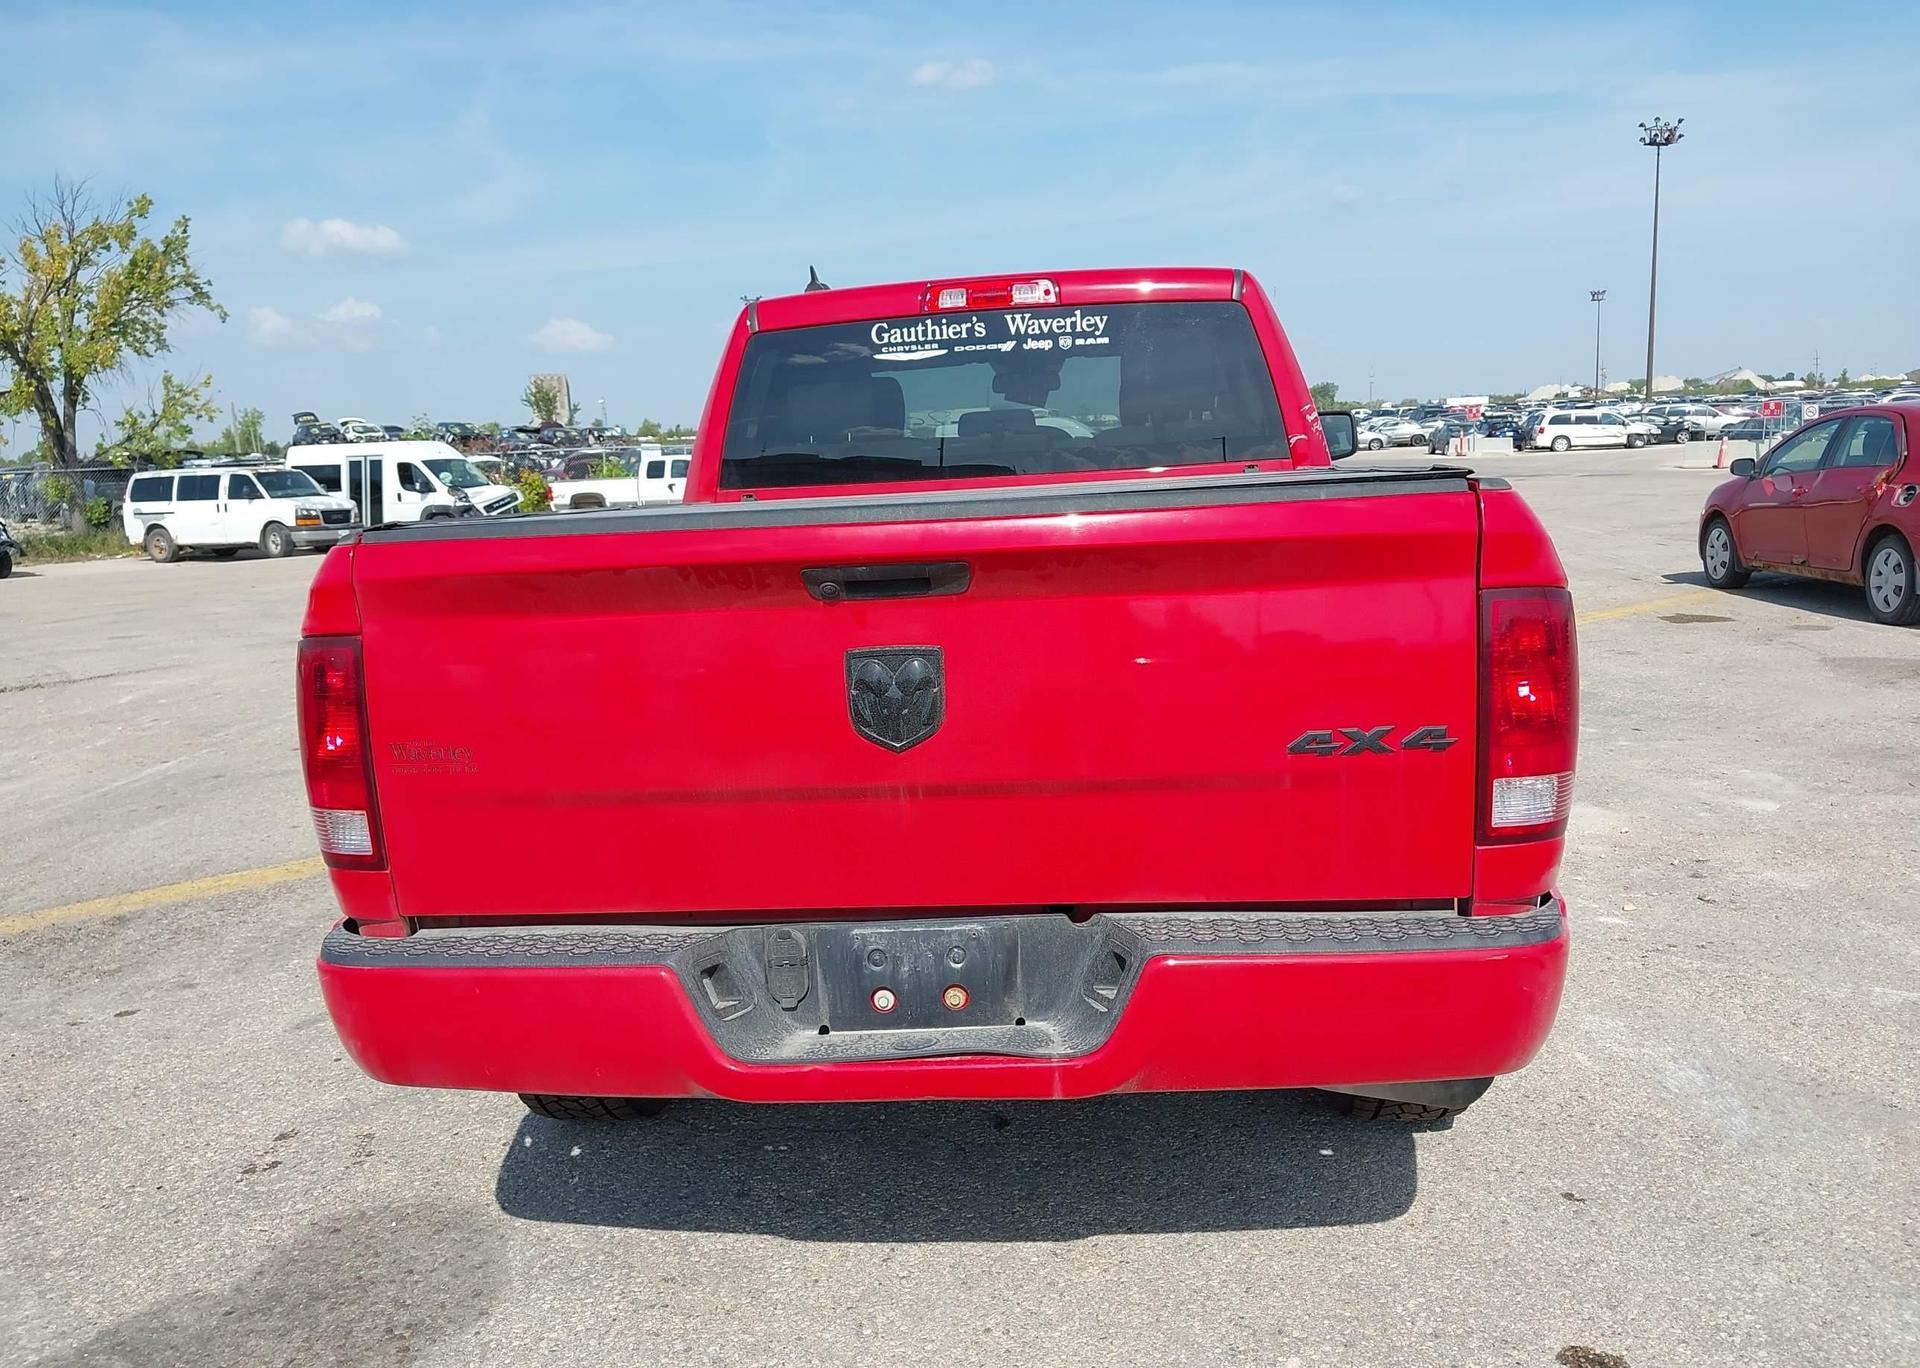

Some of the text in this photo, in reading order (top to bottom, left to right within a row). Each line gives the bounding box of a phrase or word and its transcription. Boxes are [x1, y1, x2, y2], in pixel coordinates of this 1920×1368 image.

[871, 310, 1108, 345] Gauthier's Waverley
[882, 343, 938, 352] CHRYSLER
[1022, 338, 1053, 350] Jeep
[1075, 336, 1110, 345] RAM
